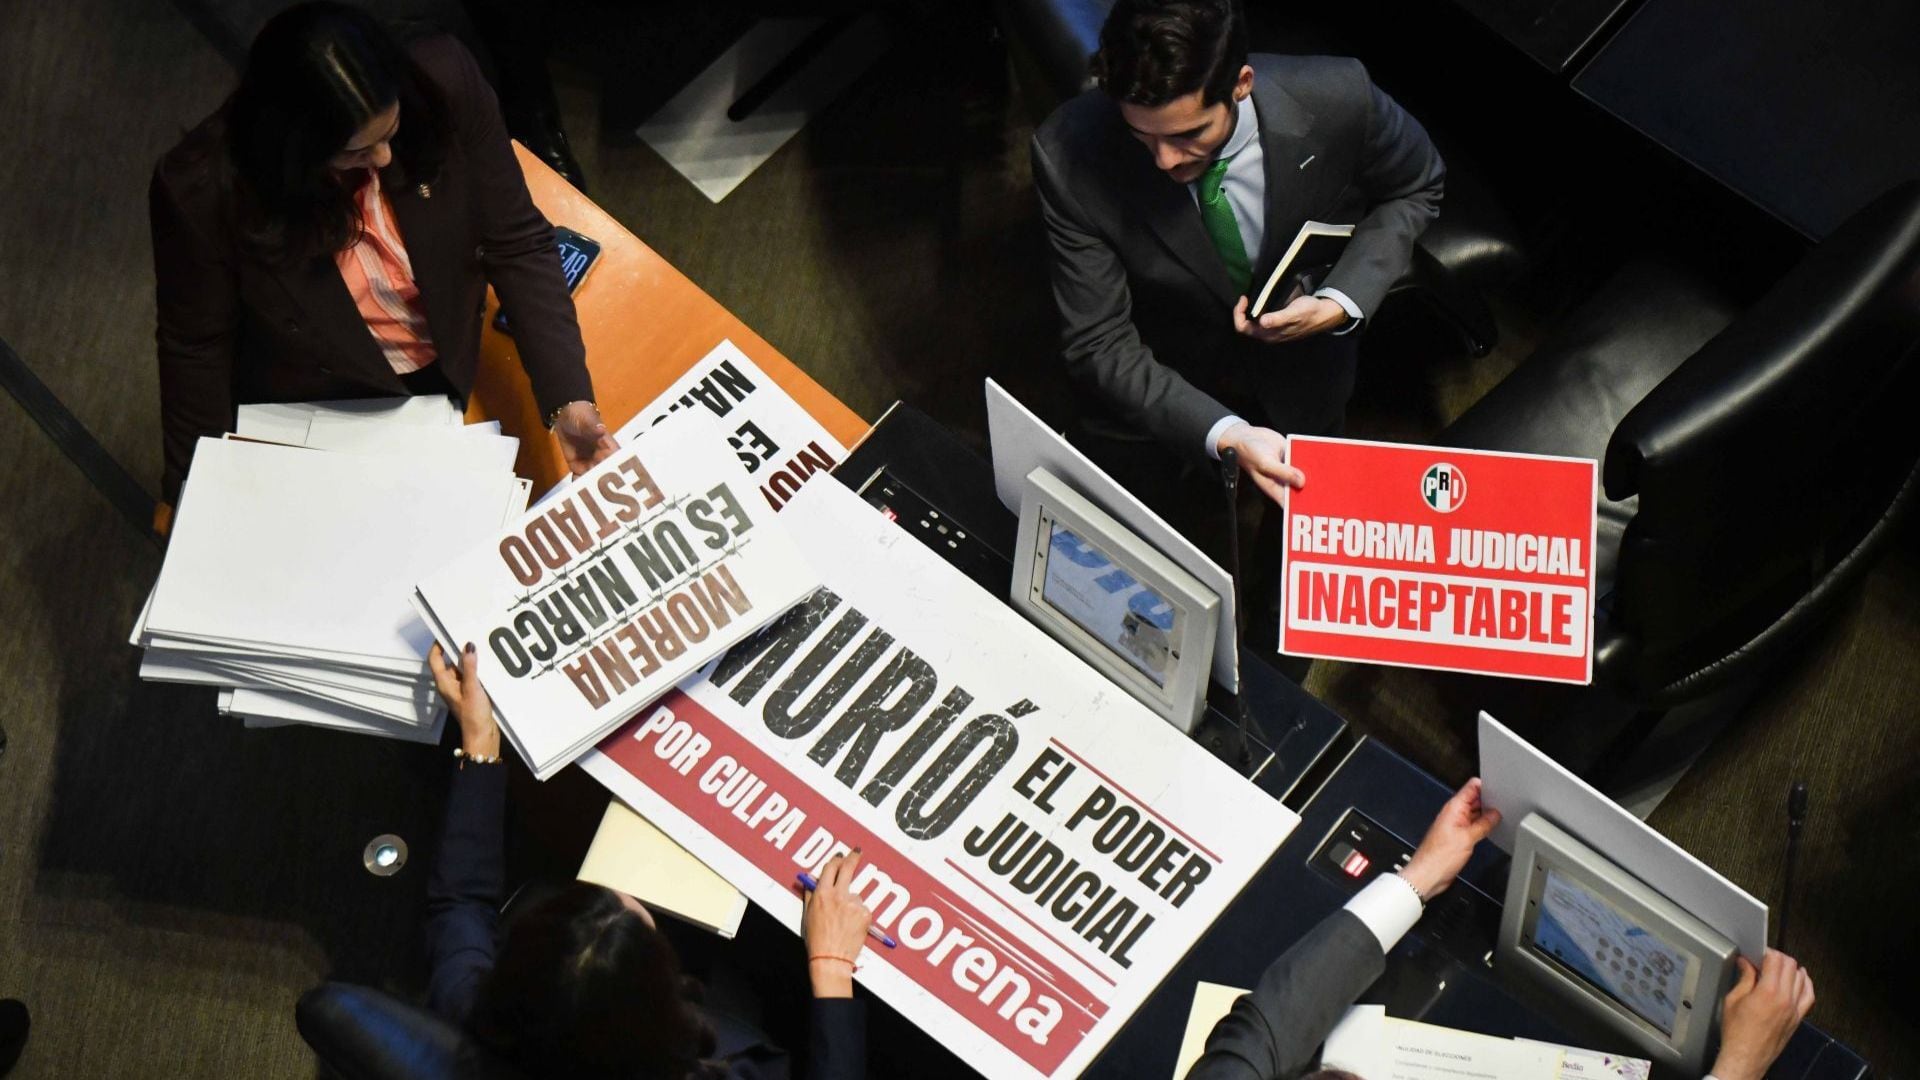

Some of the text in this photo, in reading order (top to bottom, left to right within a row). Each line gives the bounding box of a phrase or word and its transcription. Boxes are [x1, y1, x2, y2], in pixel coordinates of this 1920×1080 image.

[499, 454, 666, 586] ESTADO
[1291, 513, 1586, 577] REFORMA JUDICIAL
[1426, 471, 1459, 499] PRI
[488, 481, 754, 678] ES UN NARCO
[562, 563, 753, 710] MORENA
[1297, 569, 1573, 646] INACEPTABLE
[633, 704, 712, 776] POR
[699, 755, 807, 851] CULPA
[849, 862, 1063, 1046] morena
[963, 812, 1156, 970] JUDICIAL
[1012, 746, 1212, 909] EL PODER
